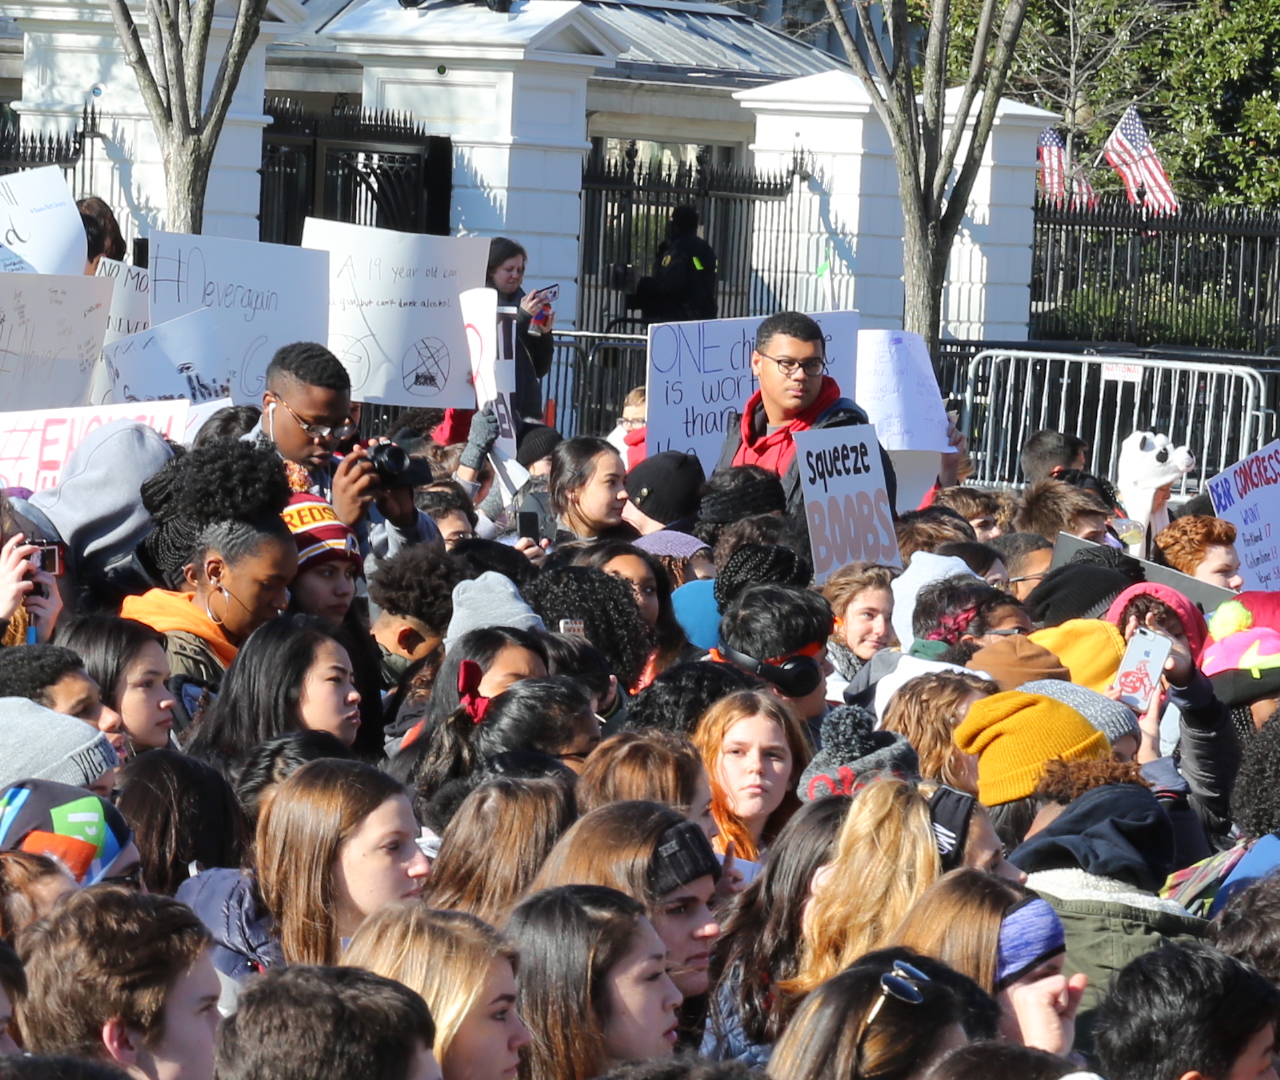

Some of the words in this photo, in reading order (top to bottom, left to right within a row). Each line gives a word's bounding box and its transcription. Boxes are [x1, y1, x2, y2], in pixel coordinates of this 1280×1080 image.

[337, 255, 356, 279] A
[369, 257, 382, 280] 19
[391, 266, 418, 283] year
[425, 267, 438, 278] old
[420, 298, 452, 308] alcohol
[651, 320, 723, 377] ONE
[665, 379, 684, 405] is
[701, 374, 759, 405] wort
[806, 441, 871, 494] squeeze
[1209, 477, 1236, 514] DEAR
[807, 487, 898, 575] BOOBS
[1264, 523, 1272, 539] 17
[1244, 551, 1271, 570] Columbine
[1271, 546, 1279, 561] 13
[1255, 571, 1272, 590] Vegas
